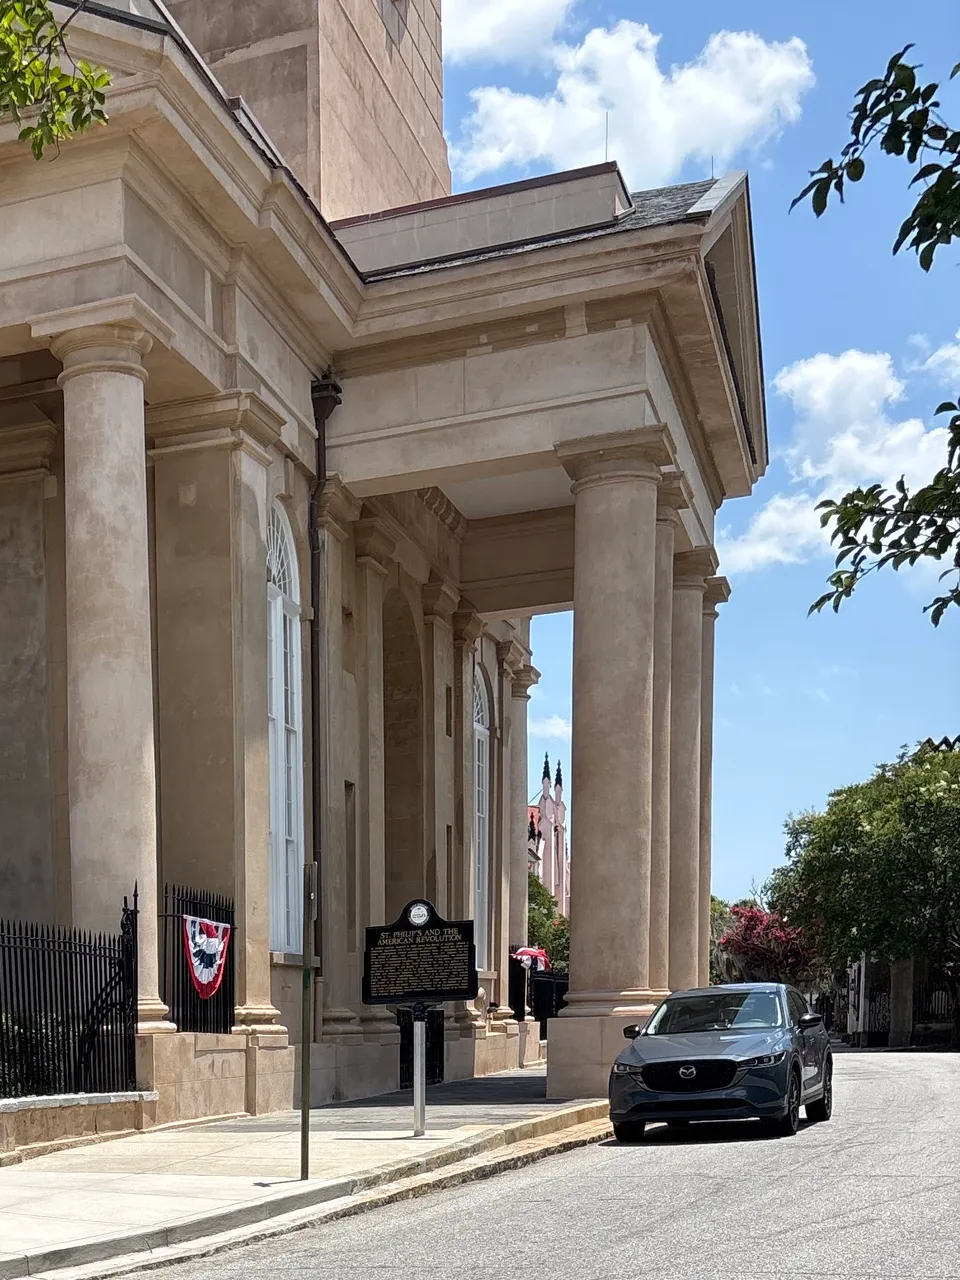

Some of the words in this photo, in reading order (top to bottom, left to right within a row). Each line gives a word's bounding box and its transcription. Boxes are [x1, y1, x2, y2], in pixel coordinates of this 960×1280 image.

[393, 930, 422, 938] PHILIP'S
[425, 928, 441, 936] AND
[378, 937, 414, 946] AMERICAN
[416, 934, 462, 943] REVOLUTION
